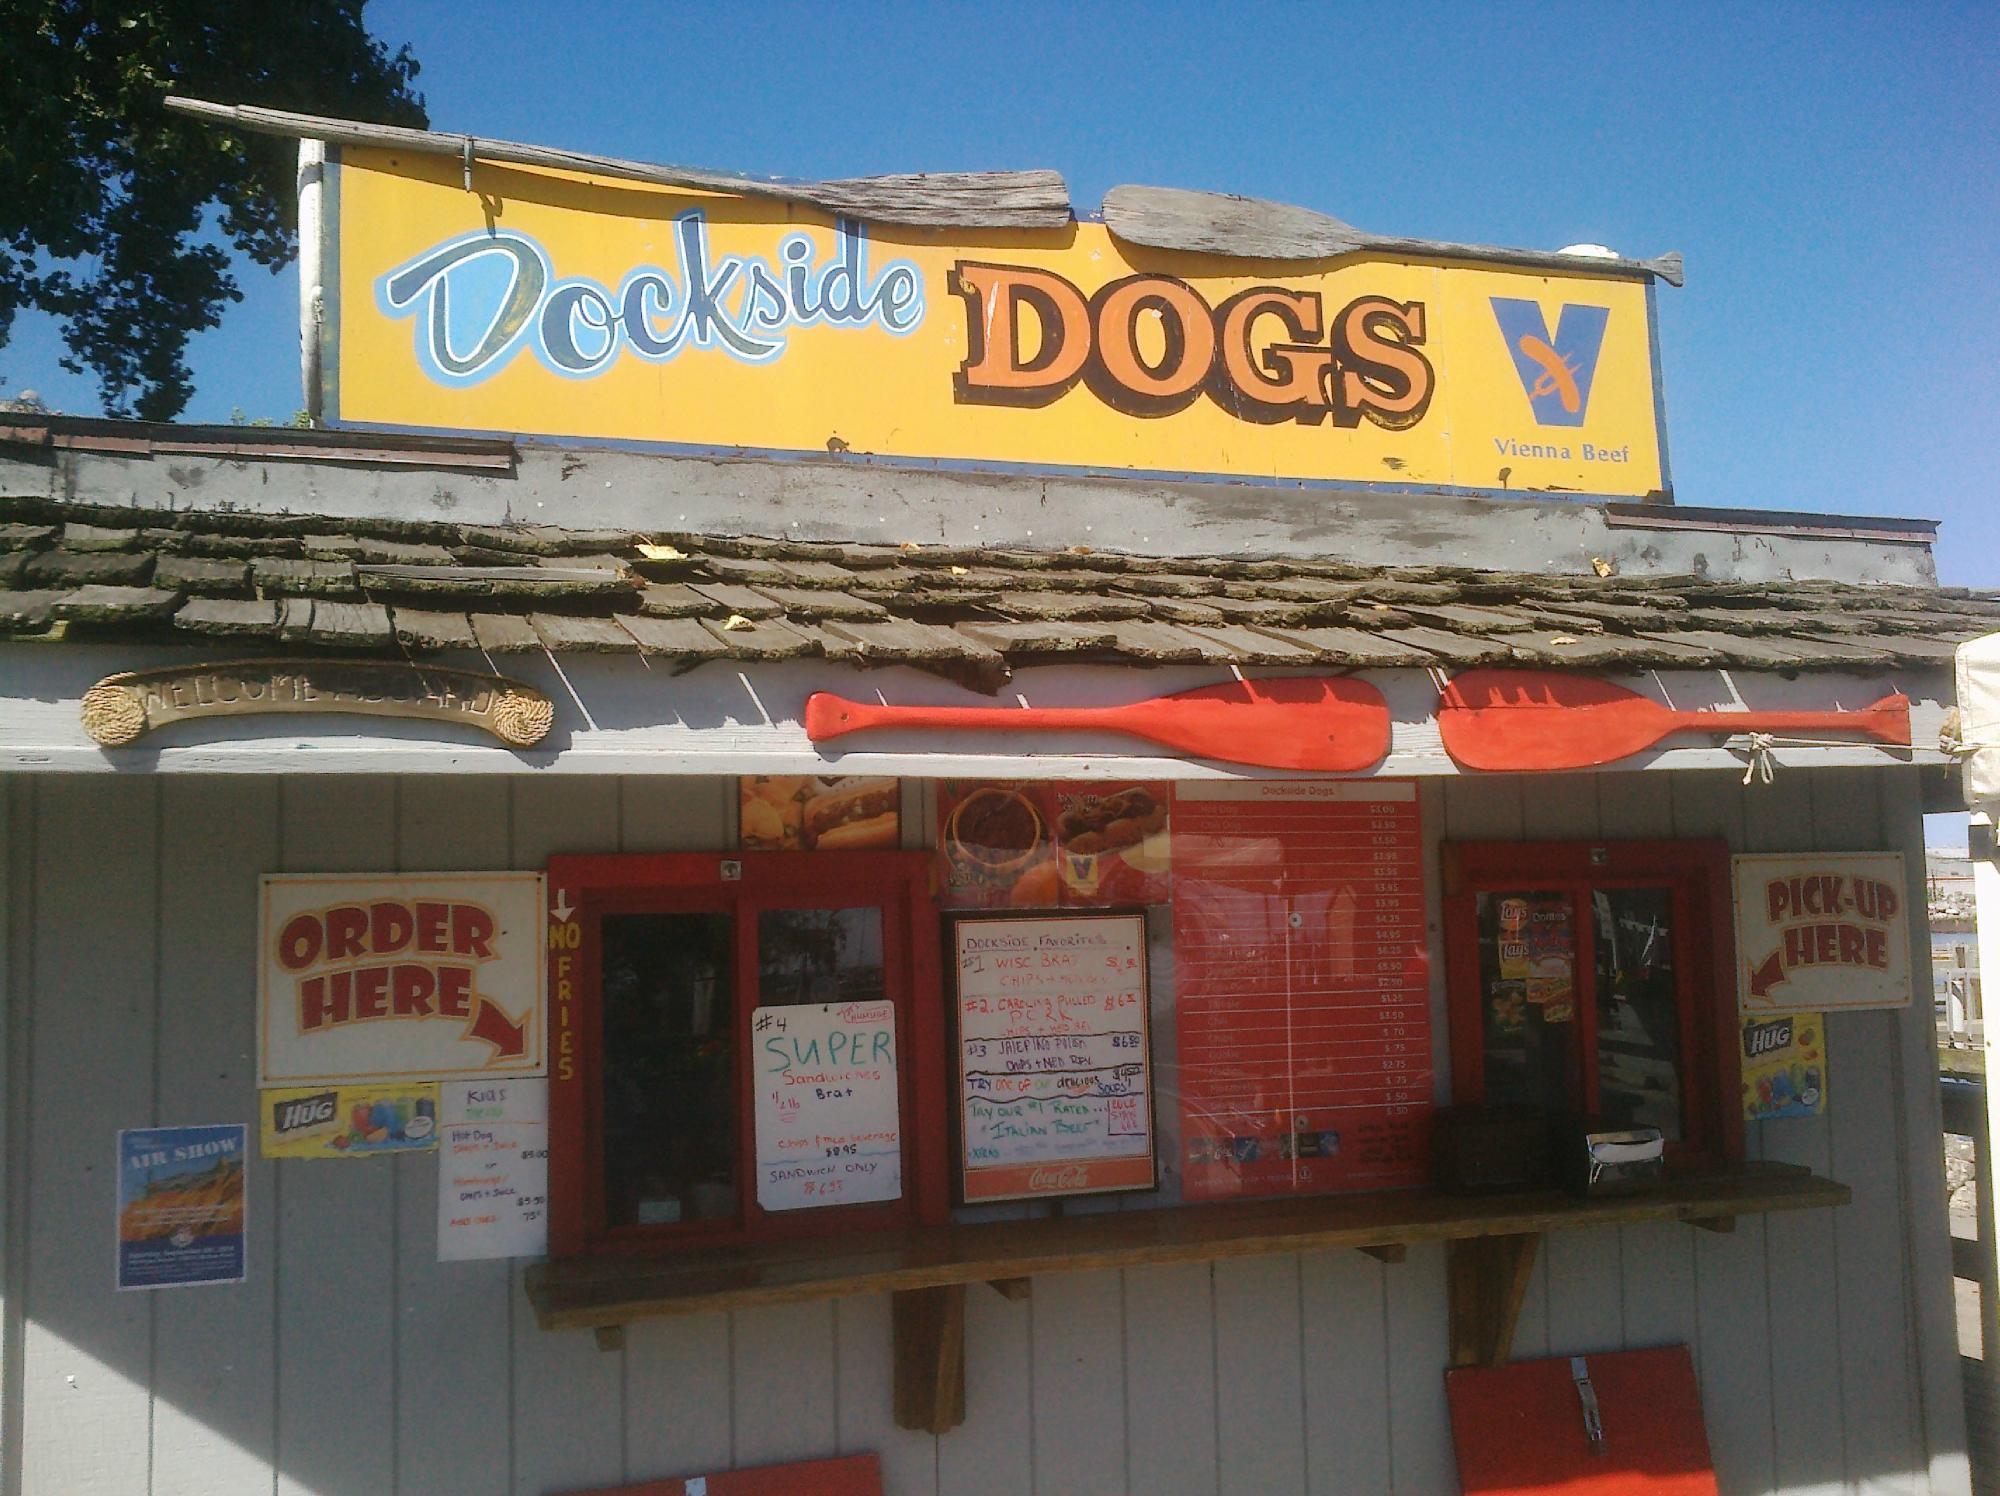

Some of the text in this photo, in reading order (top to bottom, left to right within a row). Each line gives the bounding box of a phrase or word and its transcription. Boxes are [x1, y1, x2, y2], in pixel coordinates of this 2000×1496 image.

[384, 213, 1435, 430] Dockside DOGS
[1495, 437, 1630, 463] Vienna Beef
[143, 674, 319, 714] WELCOME
[1263, 785, 1334, 798] Dockside Dogs
[1767, 876, 1898, 921] PICK-UP
[279, 902, 494, 969] ORDER
[550, 922, 580, 949] NO
[1783, 924, 1888, 968] HERE
[962, 954, 1081, 974] #1 WISC BRAT
[300, 964, 473, 1030] HERE
[1057, 995, 1096, 1008] PULLED
[557, 956, 575, 1081] FRIES
[765, 1030, 894, 1073] SUPER
[968, 1044, 987, 1058] #3
[1750, 1023, 1792, 1057] HUG
[815, 1088, 853, 1100] Brat
[966, 1078, 992, 1091] TRY
[281, 1099, 335, 1130] HUG
[788, 1097, 800, 1110] lb
[996, 1106, 1023, 1118] OUR
[1027, 1101, 1044, 1114] #1
[452, 1130, 494, 1144] Hot Dog
[131, 1150, 168, 1169] AIR
[174, 1137, 238, 1162] SHOW
[769, 1162, 878, 1184] SANDWICH ONLY
